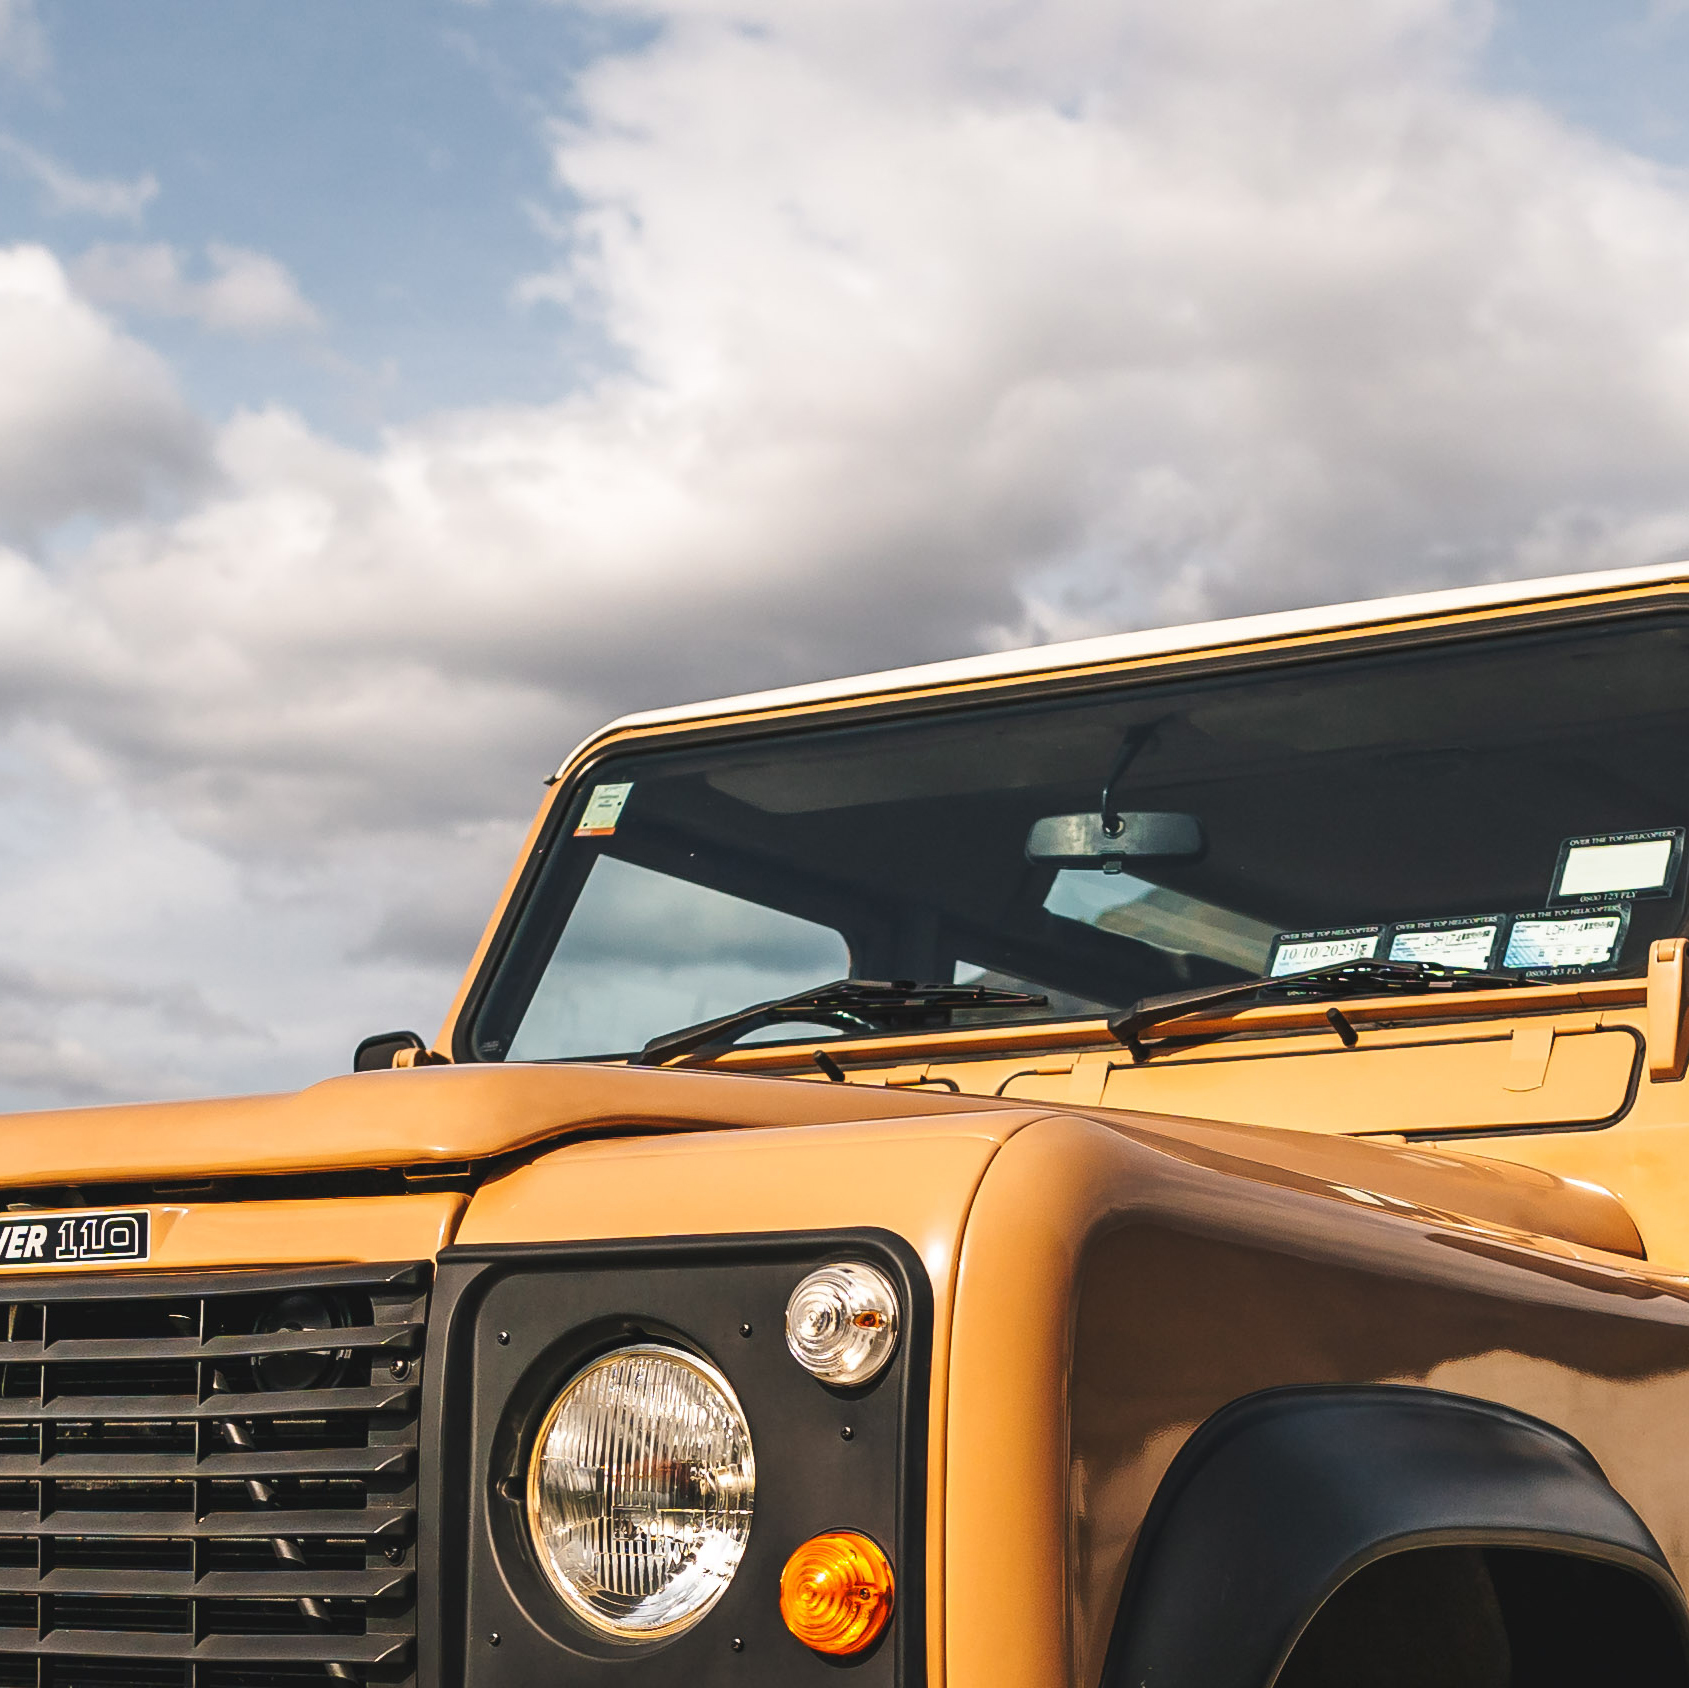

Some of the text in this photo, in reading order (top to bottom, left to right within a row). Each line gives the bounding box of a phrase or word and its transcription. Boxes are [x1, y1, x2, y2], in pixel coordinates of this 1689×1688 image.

[1569, 838, 1590, 846] OVER
[1592, 836, 1607, 844] THE
[1624, 829, 1676, 840] HELICOPTERS
[1603, 893, 1618, 901] 123
[1620, 890, 1638, 898] FLY
[1515, 912, 1536, 920] OVER
[1554, 909, 1570, 917] TOP
[1570, 904, 1622, 915] HELICOPTERS
[1331, 926, 1379, 936] HELICOPTERS
[1395, 923, 1416, 931] OVER
[1448, 916, 1498, 926] HELICOPTERS
[1282, 943, 1355, 961] 10/10/2023
[1566, 967, 1584, 975] FLY
[55, 1217, 140, 1260] 110
